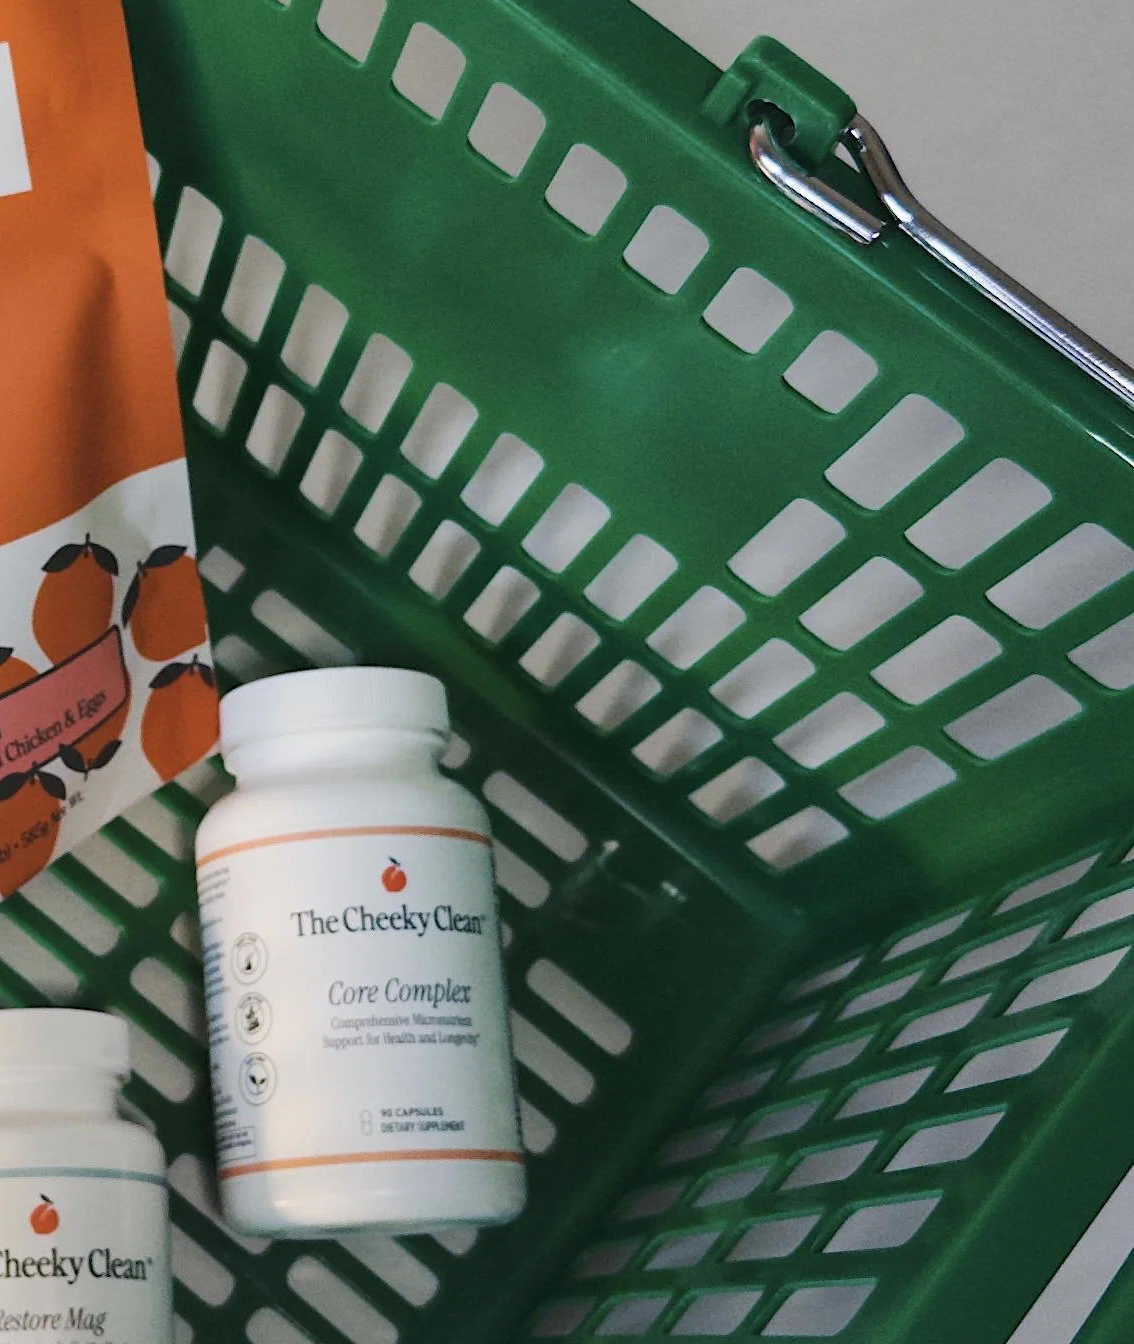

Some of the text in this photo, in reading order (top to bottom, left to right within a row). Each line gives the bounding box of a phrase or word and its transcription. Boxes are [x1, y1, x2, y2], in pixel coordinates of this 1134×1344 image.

[5, 721, 62, 762] Chicken
[64, 709, 77, 726] &
[75, 689, 107, 719] Eggs
[291, 908, 339, 938] The
[342, 905, 430, 938] Cheeky
[328, 977, 472, 1008] Core Complex
[395, 1107, 443, 1117] CAPSULES
[65, 1306, 109, 1336] Mag
